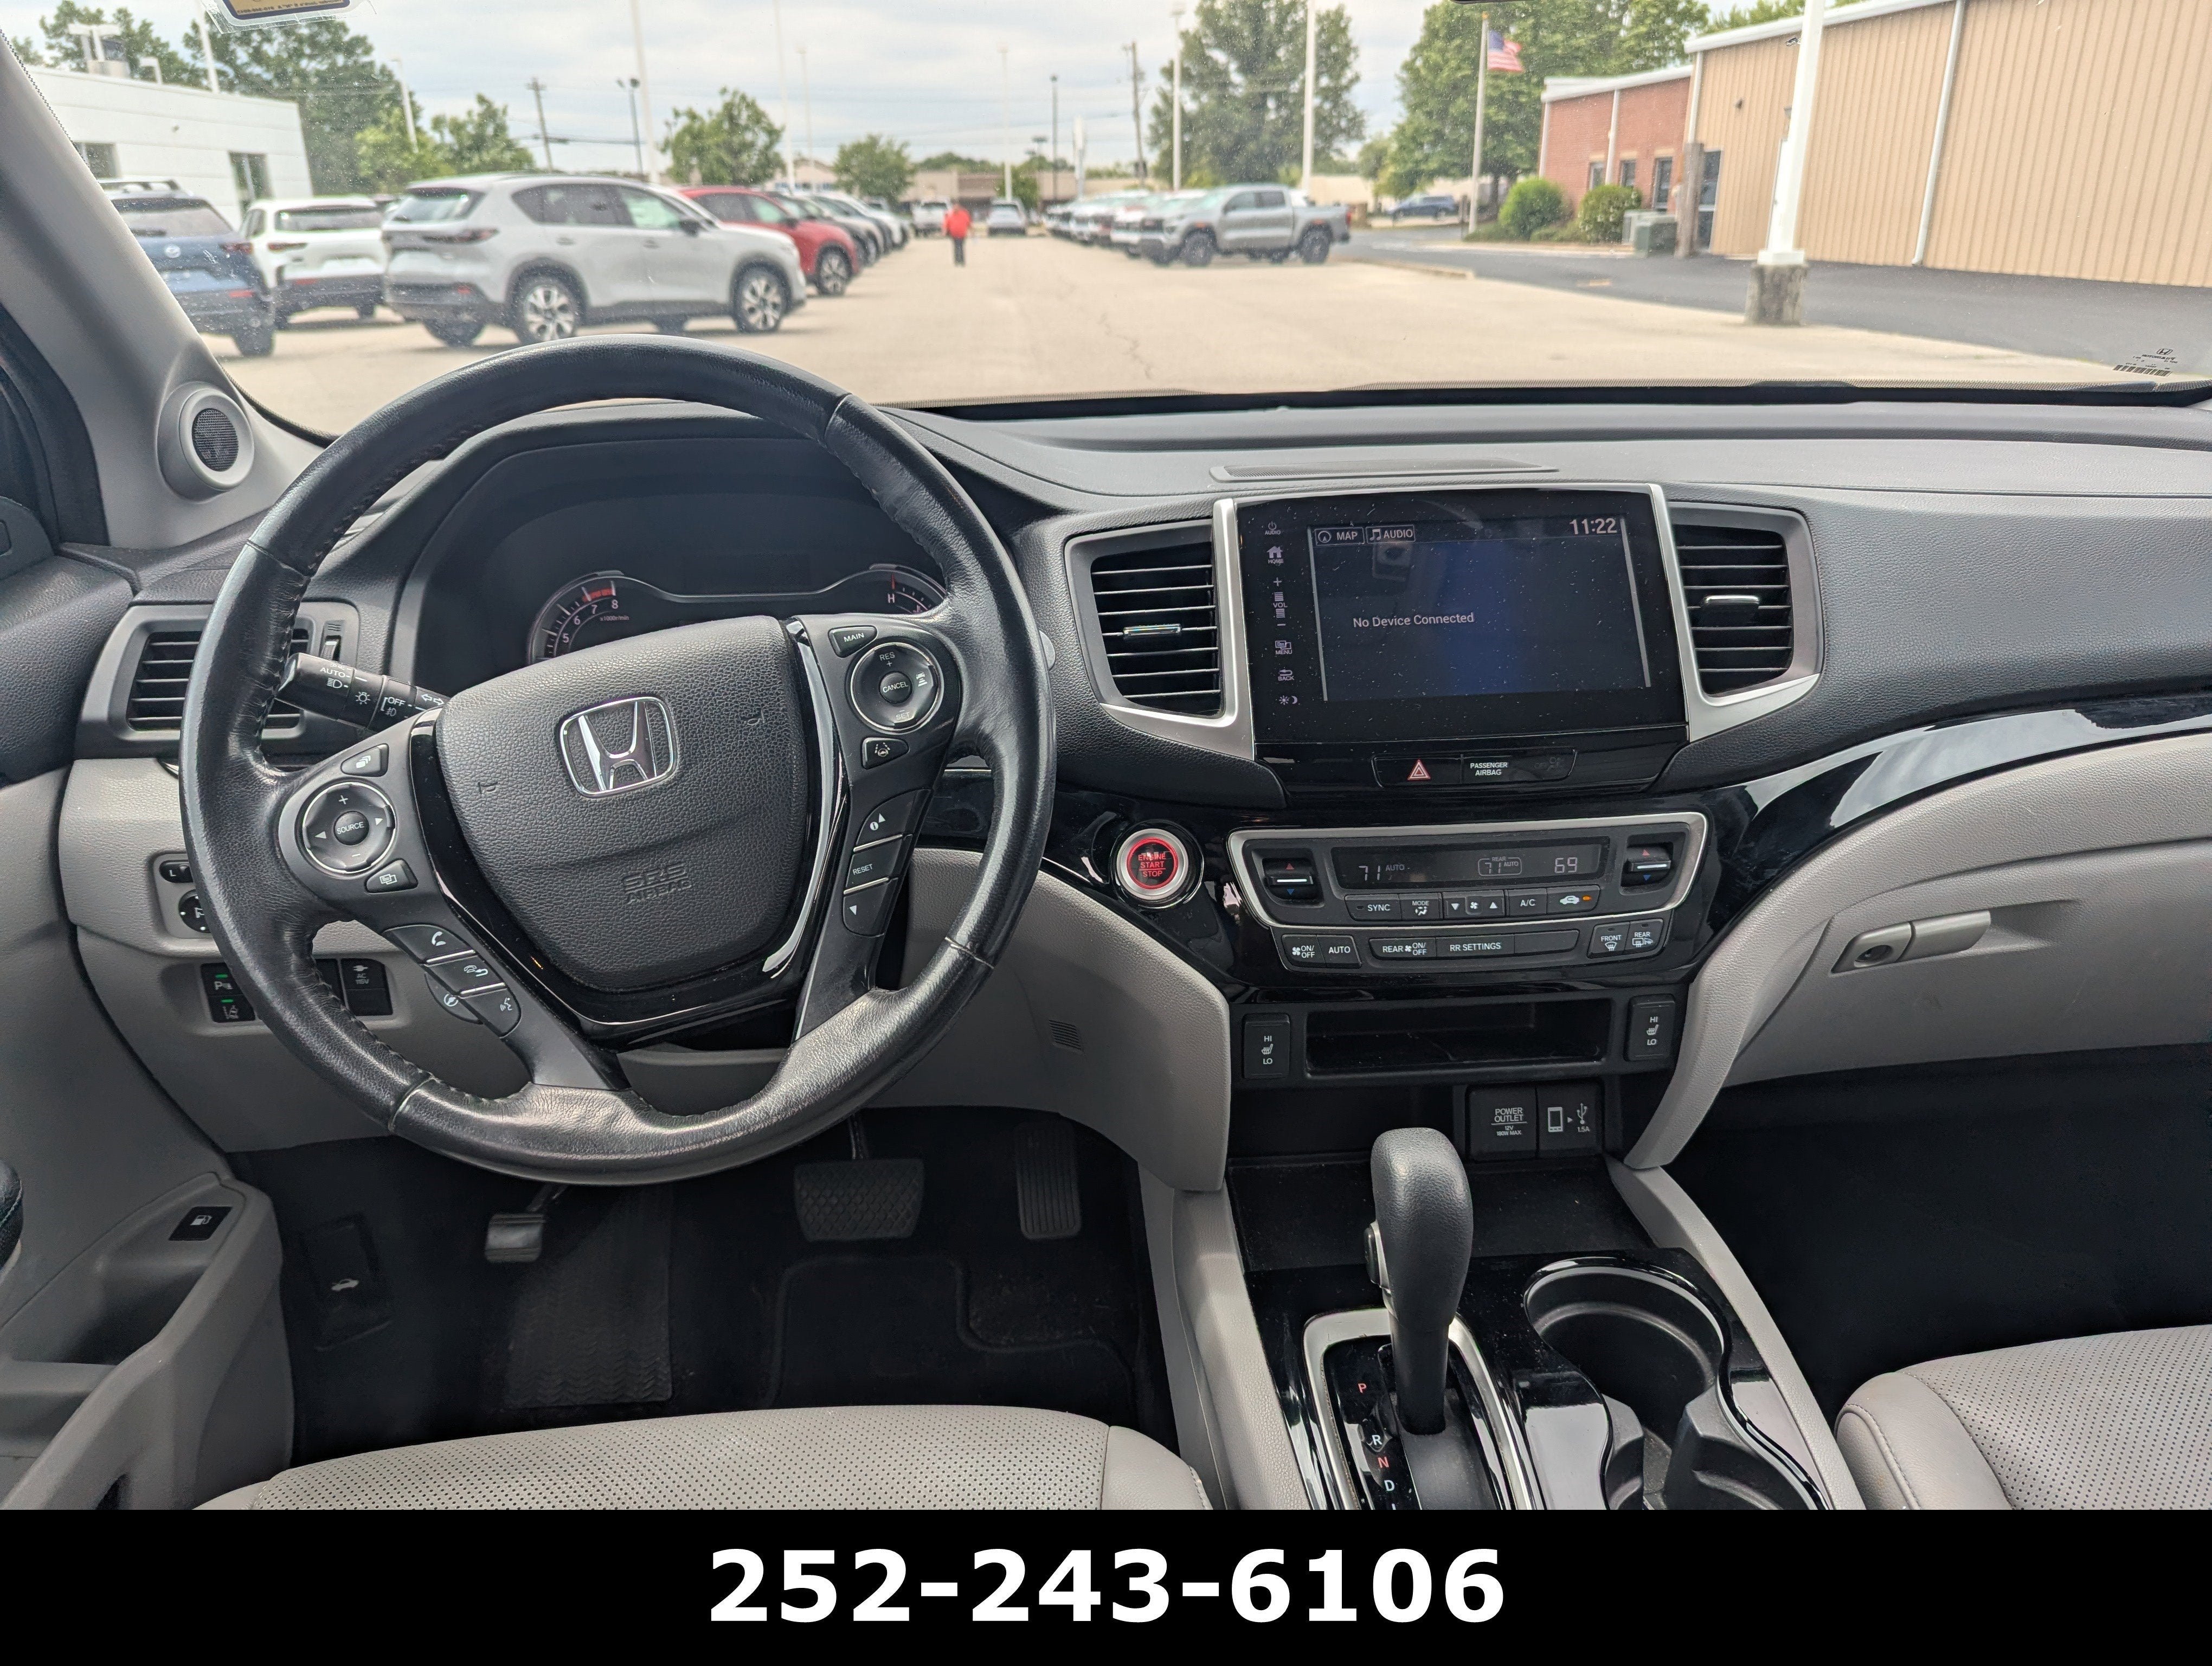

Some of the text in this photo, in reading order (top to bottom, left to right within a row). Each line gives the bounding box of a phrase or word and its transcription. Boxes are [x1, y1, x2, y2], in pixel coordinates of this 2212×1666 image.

[1570, 518, 1617, 535] 11:22
[1336, 531, 1358, 540] MAP
[1384, 529, 1413, 539] AUDIO
[888, 593, 895, 603] H
[612, 599, 618, 609] 8
[591, 605, 597, 614] 7
[574, 616, 580, 625] 6
[1353, 612, 1474, 627] No Device Connected
[562, 633, 569, 643] 5
[844, 632, 865, 643] MAIN
[879, 651, 895, 661] RES
[320, 667, 345, 678] AUTO
[883, 681, 909, 693] CANCEL
[387, 696, 406, 707] OFF
[896, 712, 910, 720] SET
[337, 821, 364, 835] SOURCE
[852, 863, 873, 875] RESET
[1554, 857, 1578, 873] 69
[1358, 863, 1405, 881] 71 AUTO
[1367, 904, 1391, 912] SYNC
[1520, 899, 1536, 907] A/C
[1301, 945, 1315, 953] ON/
[1328, 946, 1351, 954] AUTO
[1382, 945, 1404, 953] REAR
[1450, 942, 1502, 952] RR SETTINGS
[1495, 1107, 1523, 1116] POWER
[1494, 1114, 1523, 1123] OUTLET
[1358, 1383, 1367, 1394] P
[1372, 1434, 1382, 1445] R
[1378, 1457, 1390, 1468] N
[1385, 1479, 1395, 1492] D
